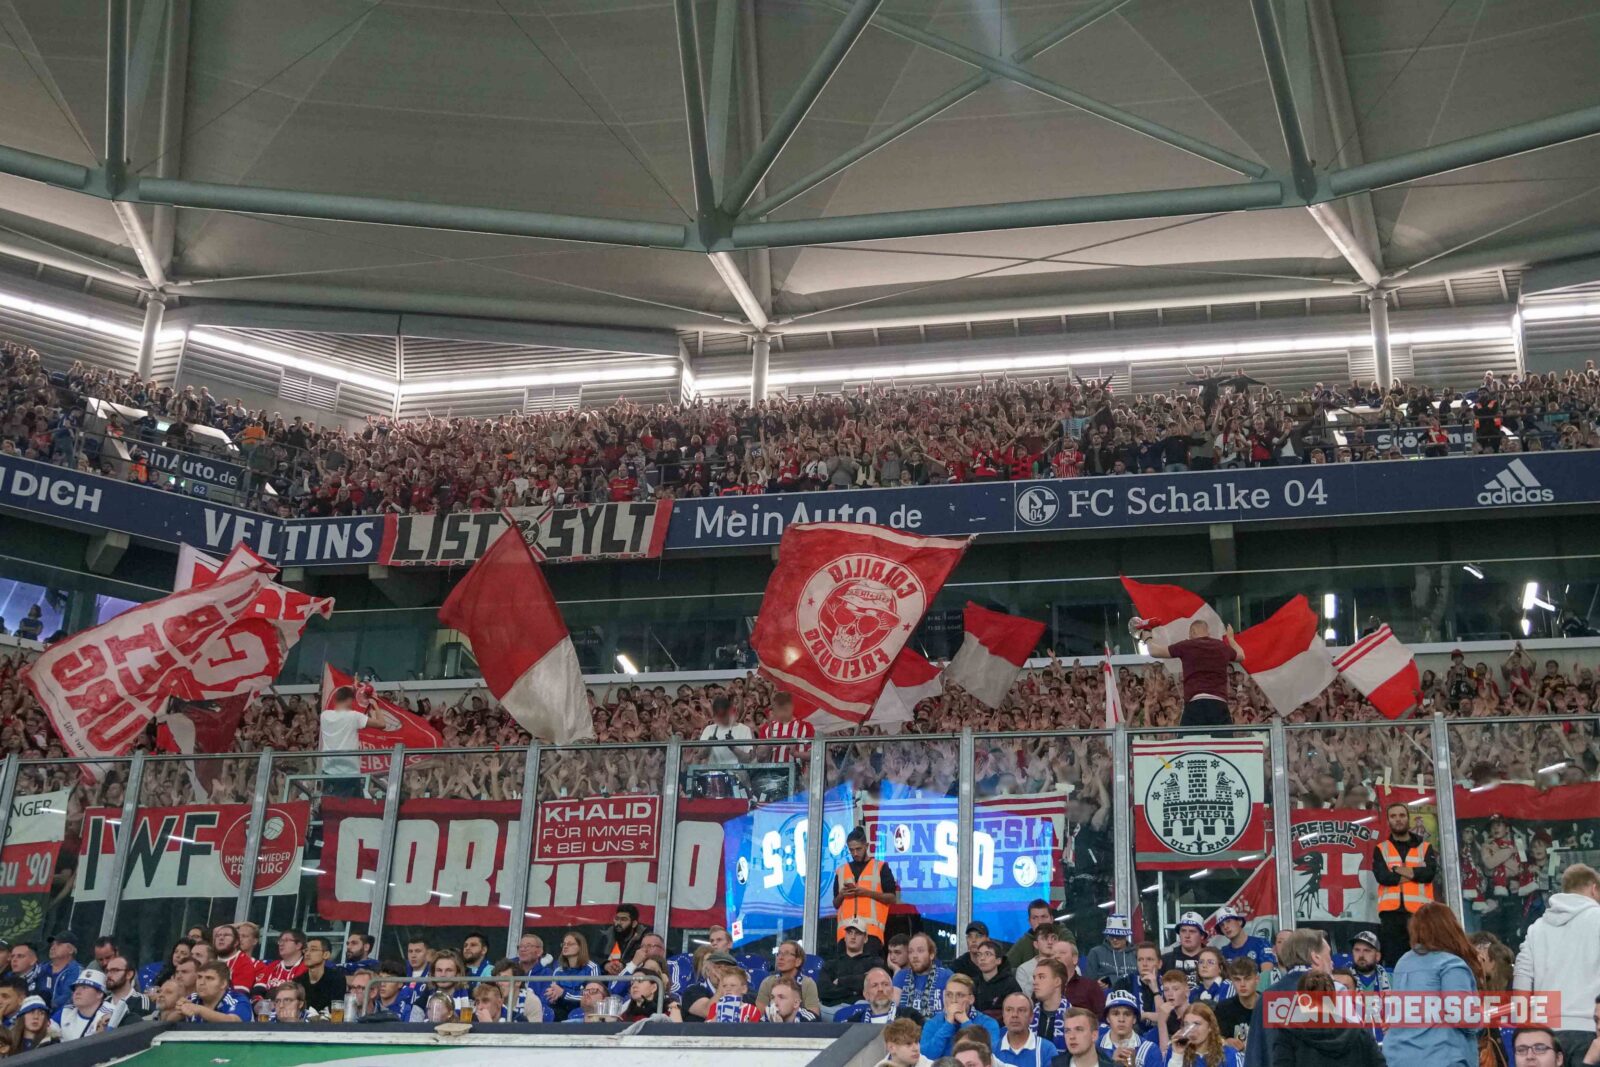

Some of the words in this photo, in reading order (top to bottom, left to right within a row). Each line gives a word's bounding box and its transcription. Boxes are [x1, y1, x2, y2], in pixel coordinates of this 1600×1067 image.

[11, 470, 102, 512] DICH
[1068, 488, 1114, 518] FC
[1128, 483, 1270, 515] Schalke
[1284, 478, 1328, 508] 04
[1477, 486, 1554, 506] adidas
[695, 502, 922, 539] MeinAuto.de
[204, 508, 375, 560] VELTINS
[392, 513, 500, 560] LIST
[546, 503, 656, 557] SYLT
[545, 802, 652, 823] KHALID
[1163, 810, 1234, 820] SYNTHESIA
[543, 824, 581, 840] FÜR
[587, 824, 652, 838] IMMER
[84, 812, 220, 891] IWF
[557, 841, 586, 854] BEI
[592, 840, 635, 853] UNS
[1170, 836, 1230, 852] ULTRAS
[230, 862, 283, 876] FRURG
